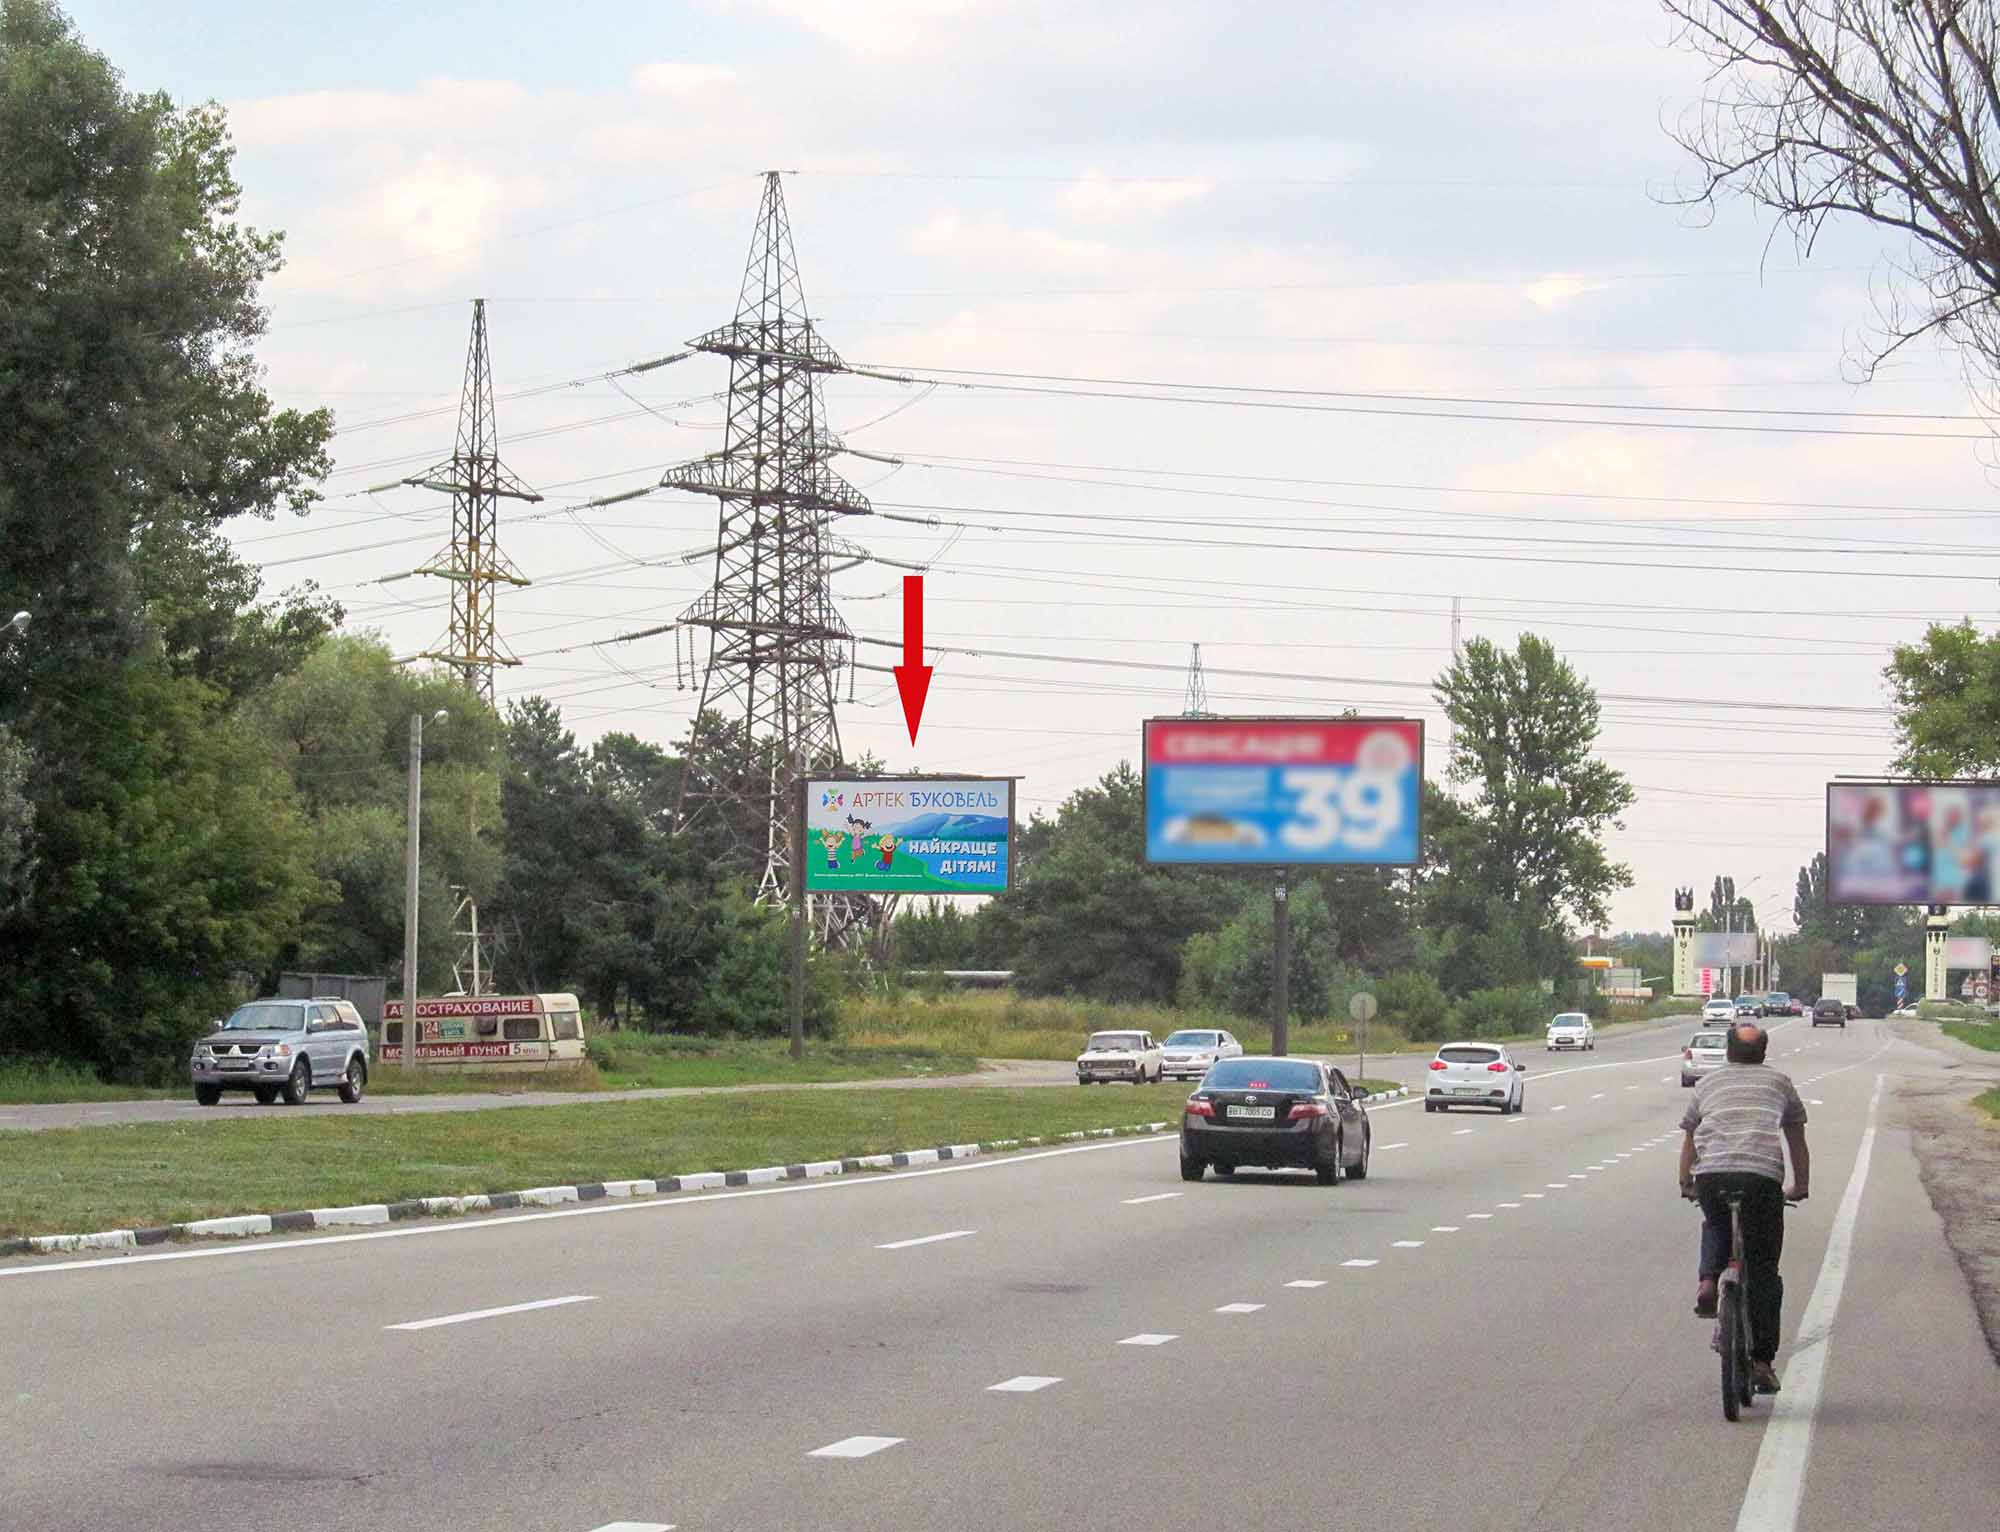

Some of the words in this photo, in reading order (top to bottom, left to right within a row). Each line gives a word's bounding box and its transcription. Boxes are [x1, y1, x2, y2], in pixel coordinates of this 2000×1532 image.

[852, 792, 904, 807] АРТЕК
[909, 792, 998, 807] БУКОВЕЛЬ
[909, 839, 997, 855] НАЙКРАЩЕ
[940, 860, 996, 874] ДІТЯМ!
[426, 1022, 438, 1033] 24
[470, 1045, 507, 1057] ПУНКТ
